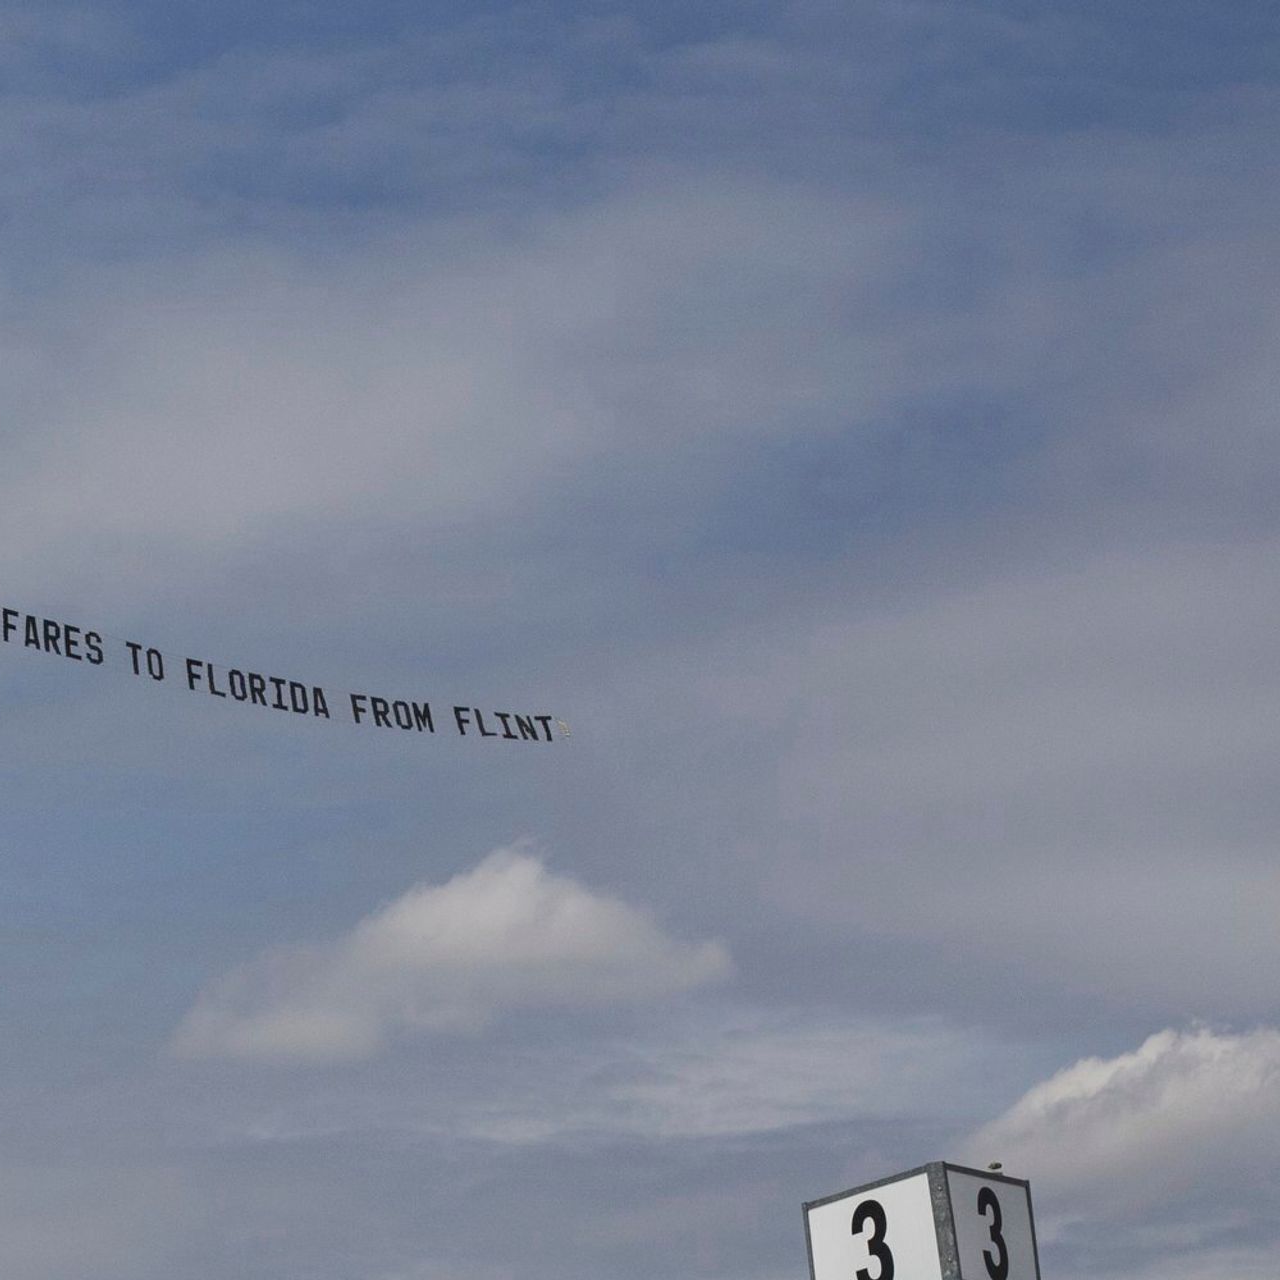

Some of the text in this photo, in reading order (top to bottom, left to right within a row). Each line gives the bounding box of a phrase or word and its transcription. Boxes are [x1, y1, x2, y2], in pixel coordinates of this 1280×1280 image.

[2, 607, 104, 666] FARES
[126, 640, 164, 681] TO
[186, 658, 330, 719] FLORIDA
[350, 693, 435, 733] FROM
[453, 706, 553, 742] FLINT
